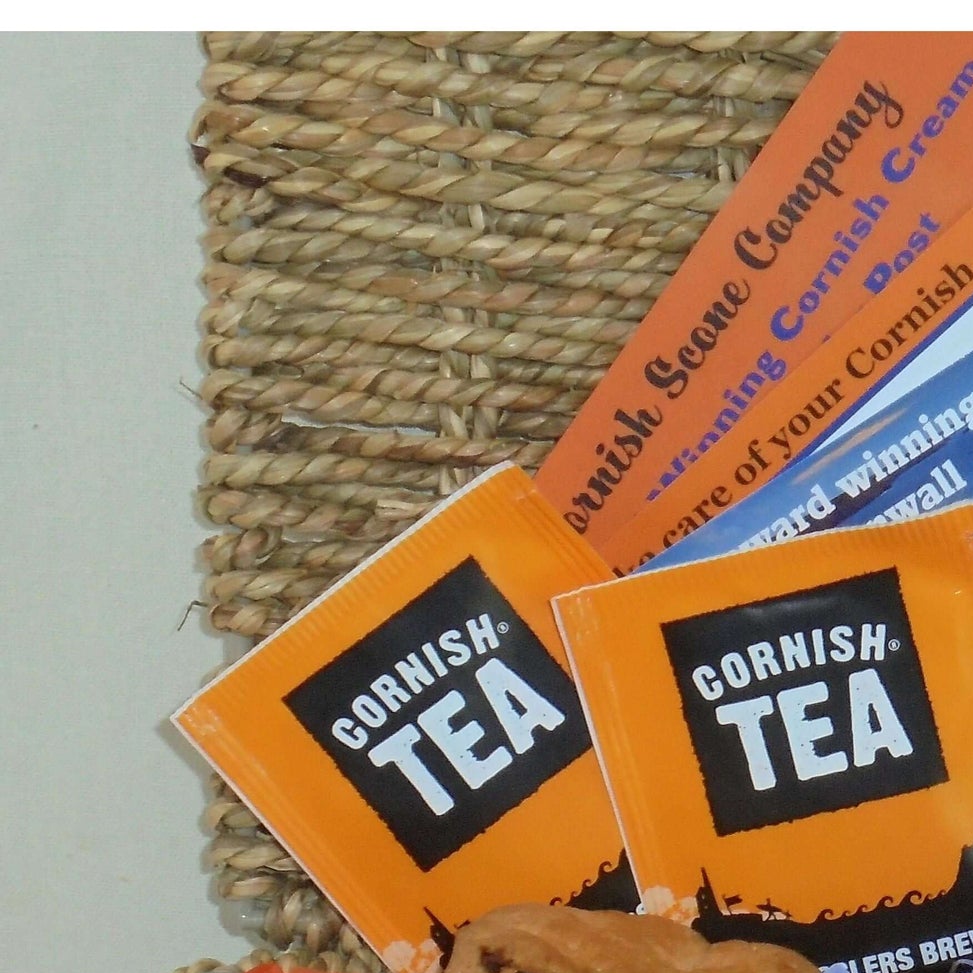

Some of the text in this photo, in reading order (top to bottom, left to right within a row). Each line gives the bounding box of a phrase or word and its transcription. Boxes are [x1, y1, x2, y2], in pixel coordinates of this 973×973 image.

[563, 405, 663, 534] ornish
[644, 279, 751, 400] Scone
[734, 79, 904, 270] Company
[770, 194, 890, 341] Cornish
[662, 485, 733, 549] care
[734, 439, 773, 486] of
[768, 379, 845, 460] your
[738, 483, 837, 549] ward
[866, 458, 968, 526] wall
[367, 657, 566, 816] TEA
[714, 667, 914, 791] TEA
